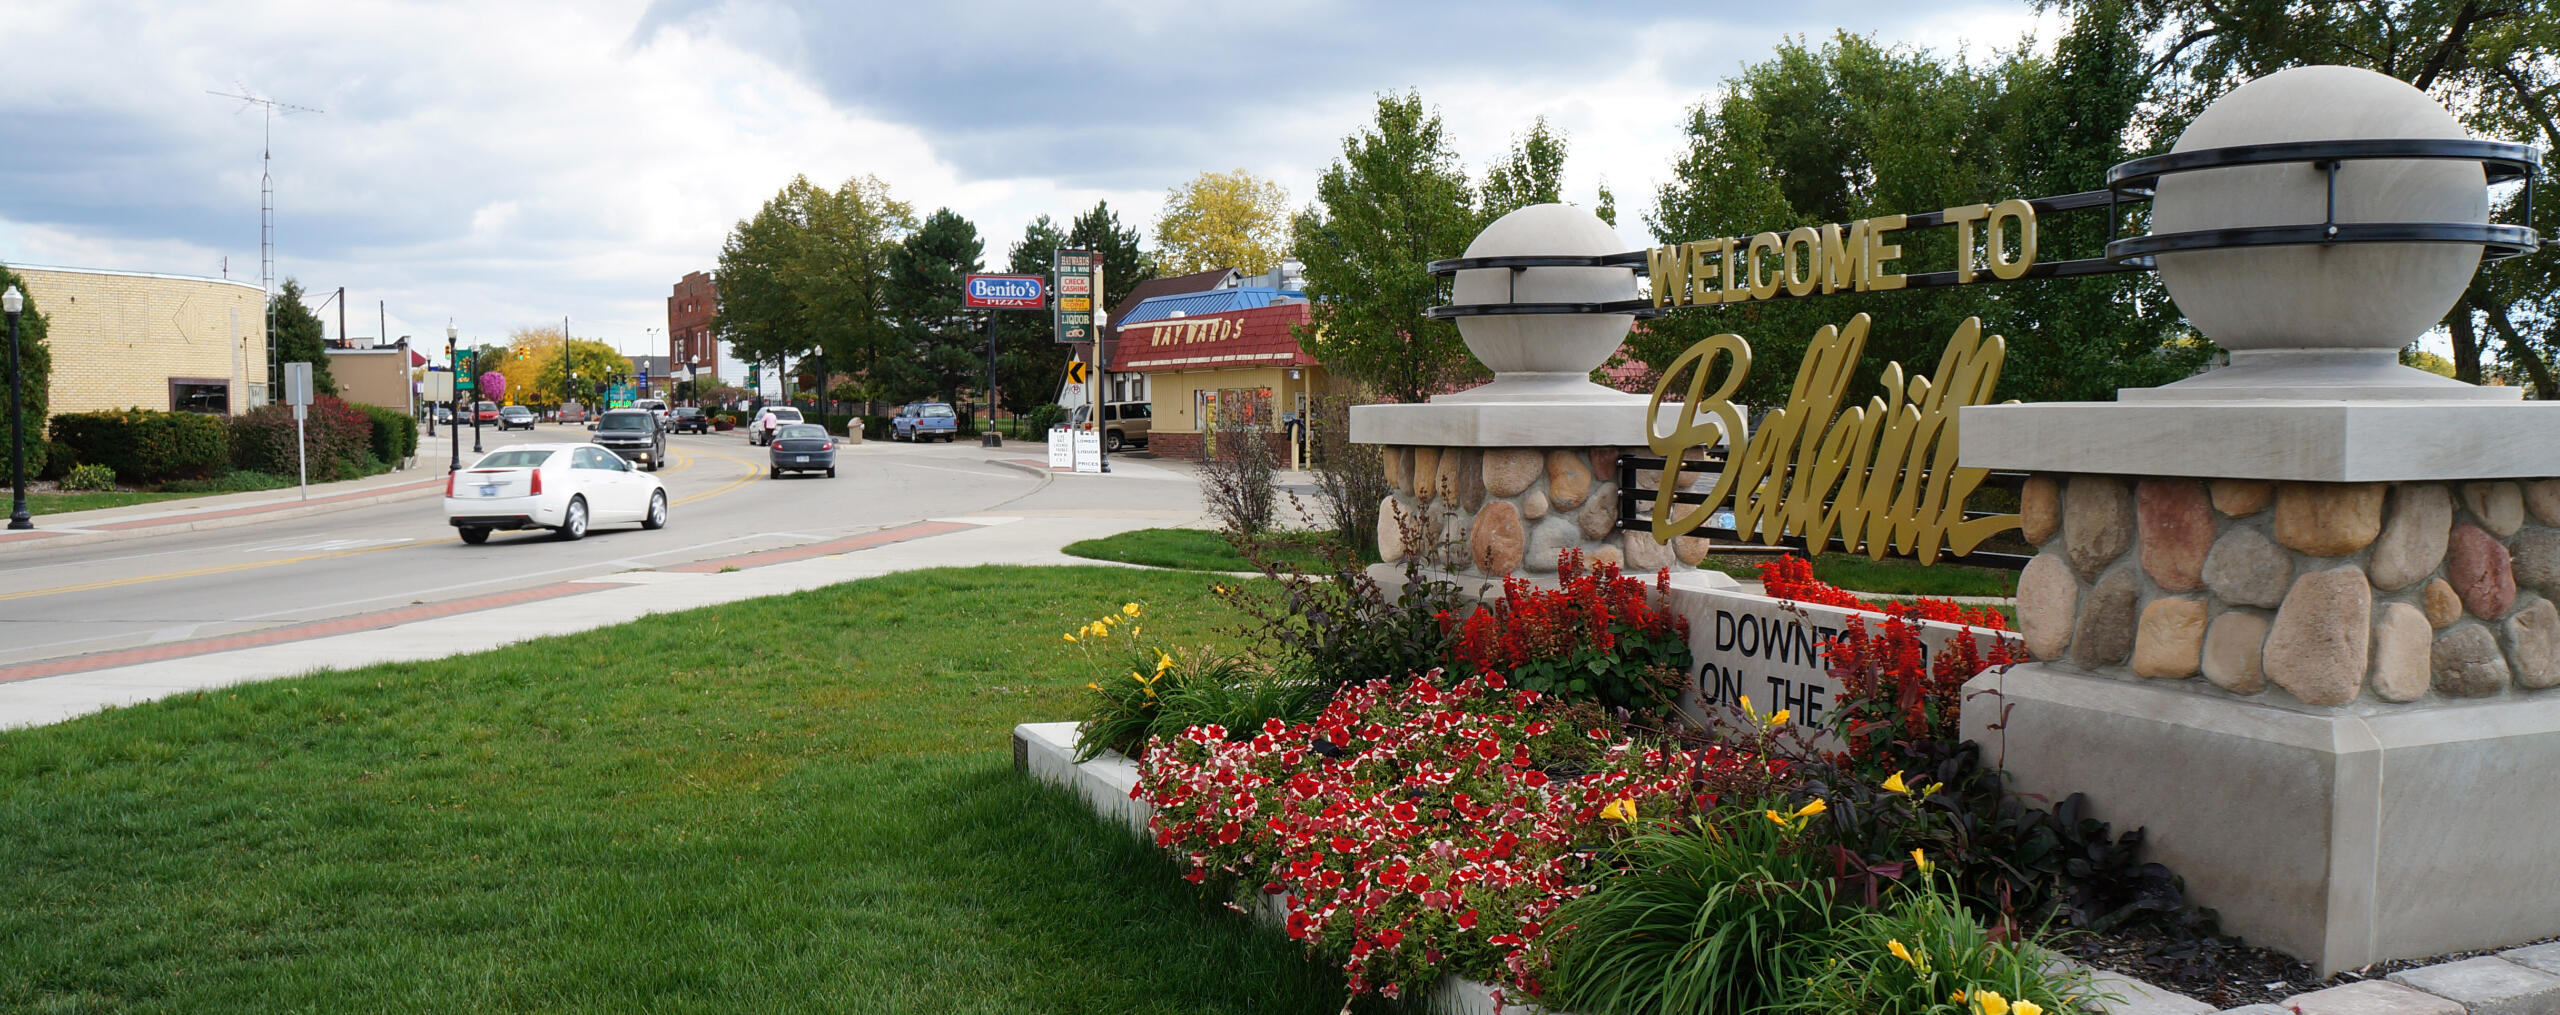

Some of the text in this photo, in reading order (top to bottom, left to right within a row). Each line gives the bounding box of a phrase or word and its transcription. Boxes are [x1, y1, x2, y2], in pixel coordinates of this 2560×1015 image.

[1061, 255, 1090, 265] HAYWARDS
[1647, 199, 2038, 309] WELCOME TO
[975, 280, 1036, 297] Benito's
[1061, 314, 1090, 325] LIQUOR
[1151, 318, 1245, 347] HAYWARDS
[1646, 312, 2023, 567] Belleville
[1699, 662, 1825, 730] ON THE
